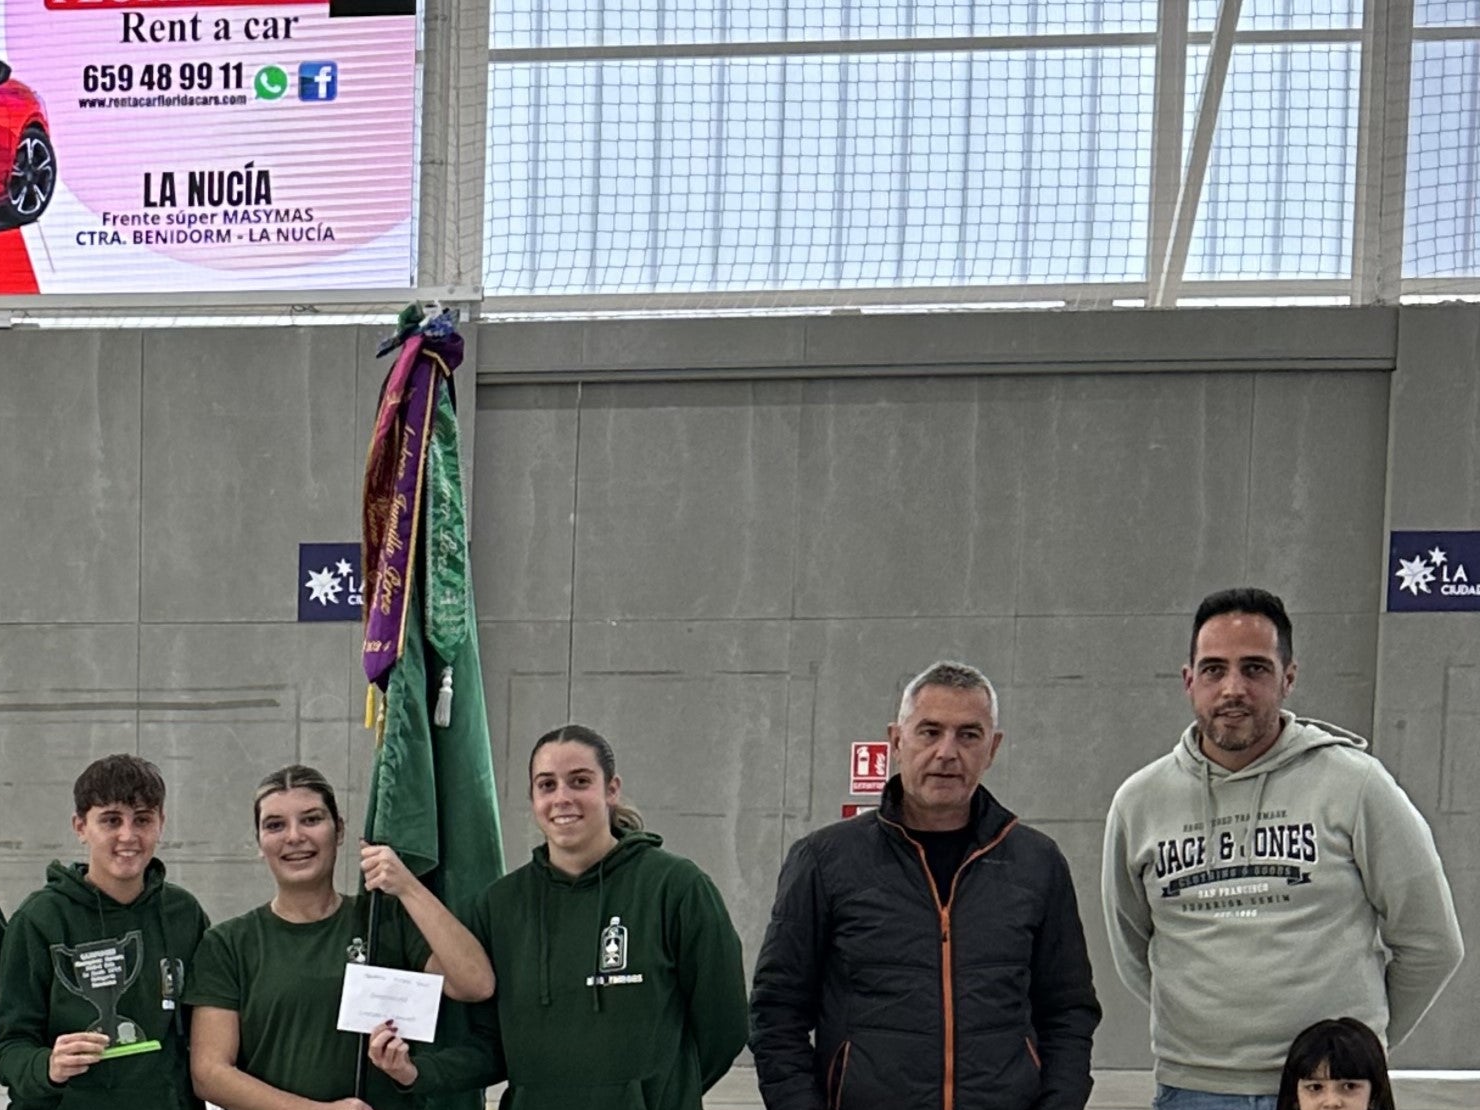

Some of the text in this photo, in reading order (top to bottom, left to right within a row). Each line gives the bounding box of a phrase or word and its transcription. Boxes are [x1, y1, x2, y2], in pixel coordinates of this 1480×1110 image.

[120, 12, 299, 43] Rent a car
[83, 61, 244, 92] 659 48 99 11
[79, 94, 247, 108] www.rentacarfloridacars.com
[144, 160, 272, 207] LA NUCÍA
[102, 208, 314, 228] Frente súper MASYMAS
[76, 230, 127, 245] CTRA.
[133, 229, 232, 245] BENIDORM
[248, 228, 271, 242] LA
[276, 222, 336, 242] NUCÍA
[1442, 564, 1468, 582] LA
[1220, 832, 1234, 860] &
